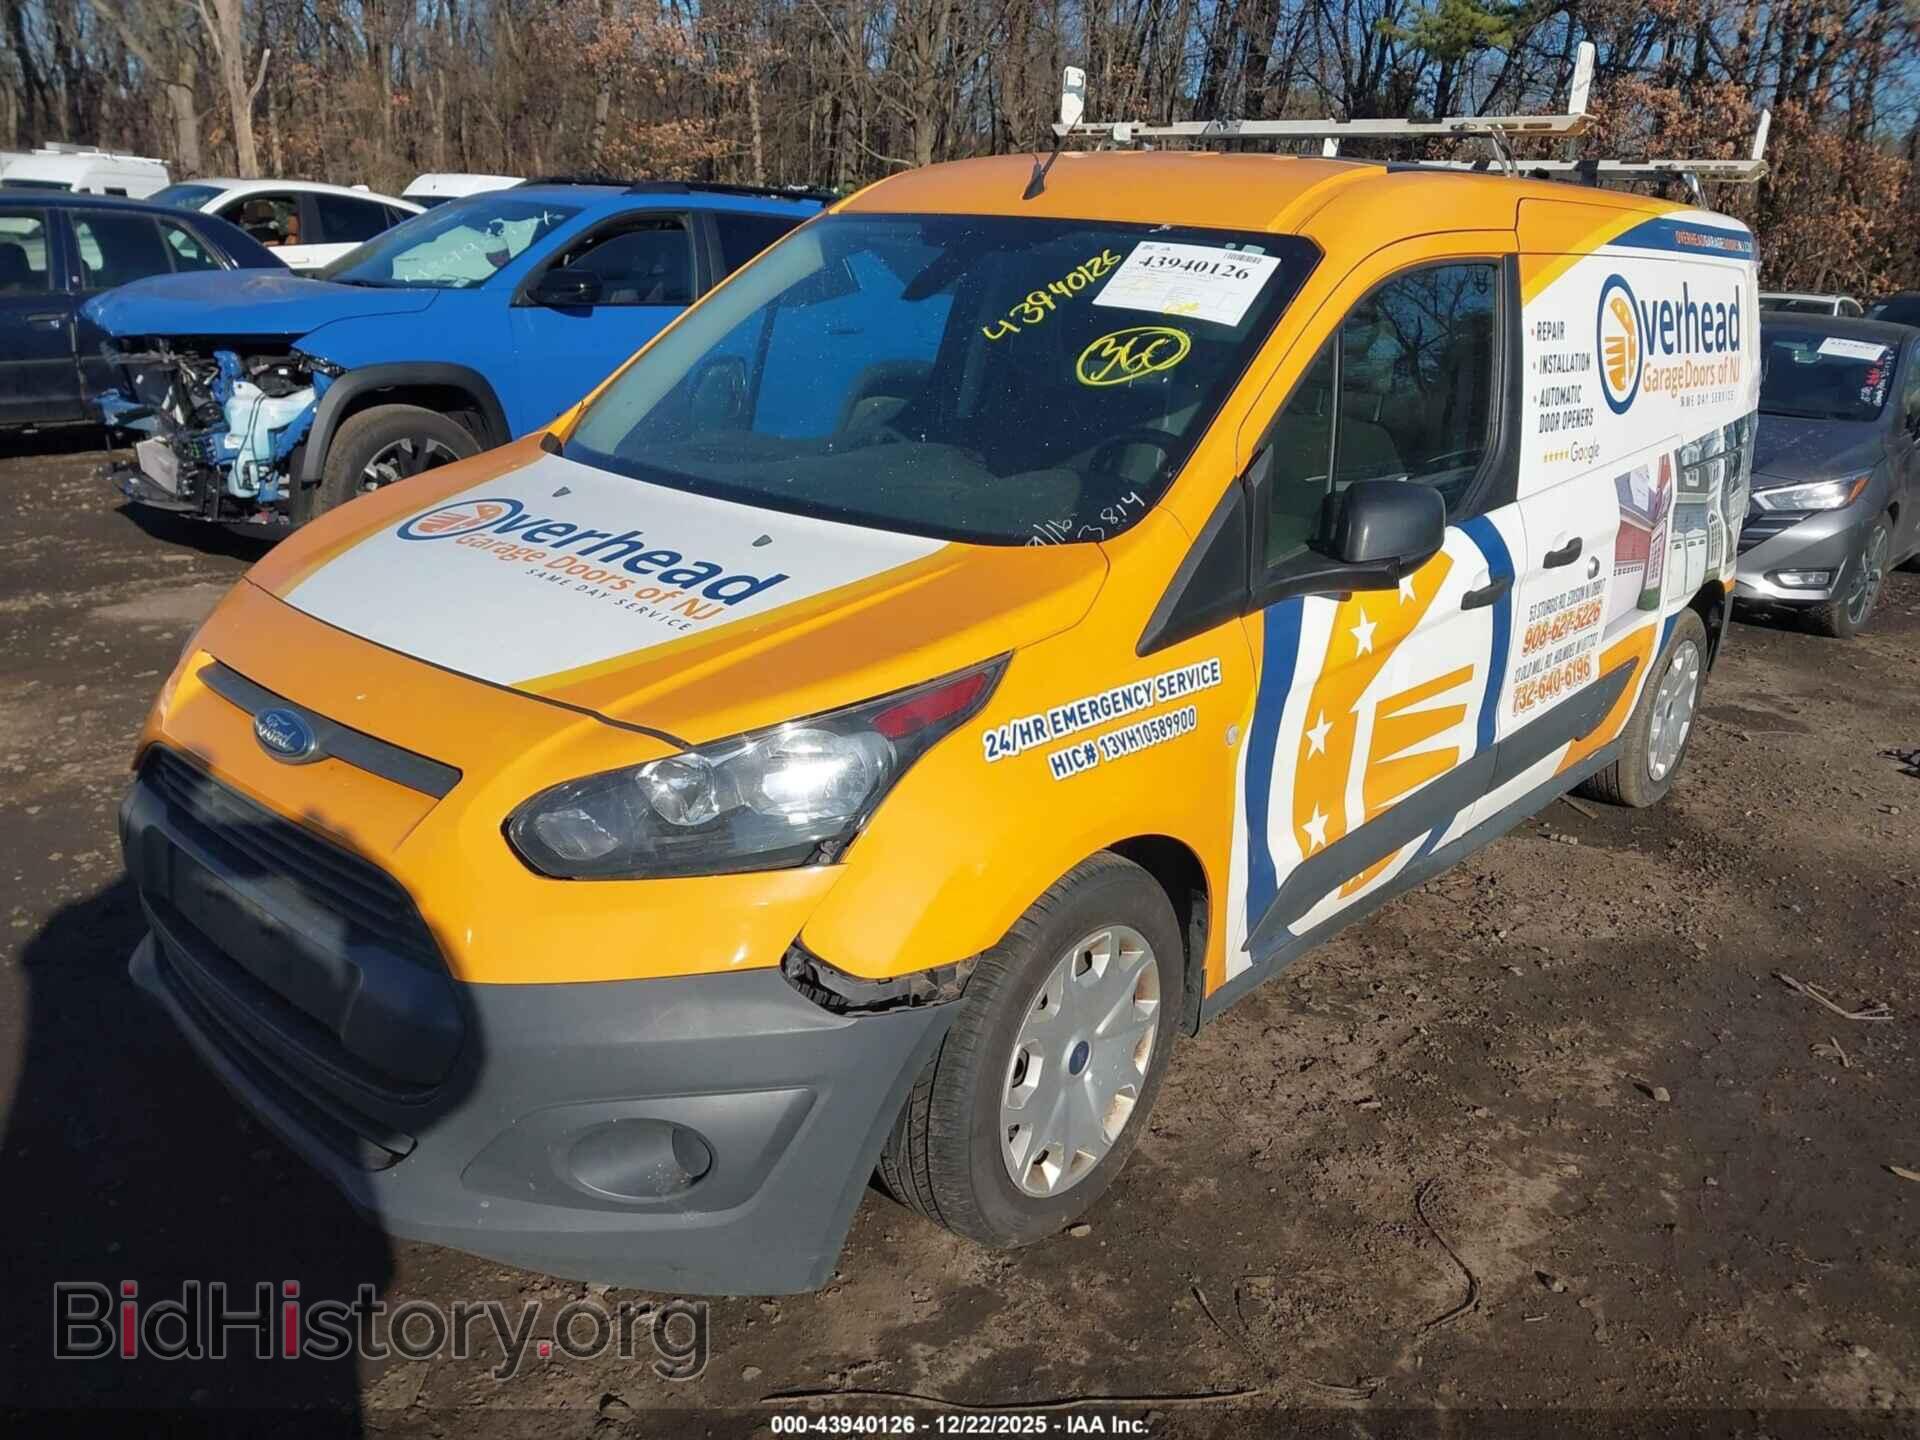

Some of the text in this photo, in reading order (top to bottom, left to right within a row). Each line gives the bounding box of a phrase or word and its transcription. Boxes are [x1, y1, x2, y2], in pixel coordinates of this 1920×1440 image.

[982, 248, 1122, 340] 43940126
[1139, 255, 1249, 281] 43940126
[1536, 320, 1566, 341] REPAIR
[1597, 274, 1740, 414] Overhead
[1539, 352, 1590, 375] INSTALLATION
[1718, 356, 1728, 385] of
[1729, 355, 1740, 384] NJ
[1538, 407, 1594, 434] DOOR OPENERS
[1539, 384, 1582, 408] AUTOMATIC
[1570, 436, 1600, 465] Google
[396, 498, 790, 606] Overhead
[456, 533, 725, 621] Garage Doors of NJ
[525, 568, 693, 632] SAME DAY SERVICE
[984, 661, 1220, 758] 24/HR EMERGENCY SERVICE
[1512, 653, 1592, 715] 732-640-6196
[1051, 707, 1196, 778] HIC# 13VH10589900
